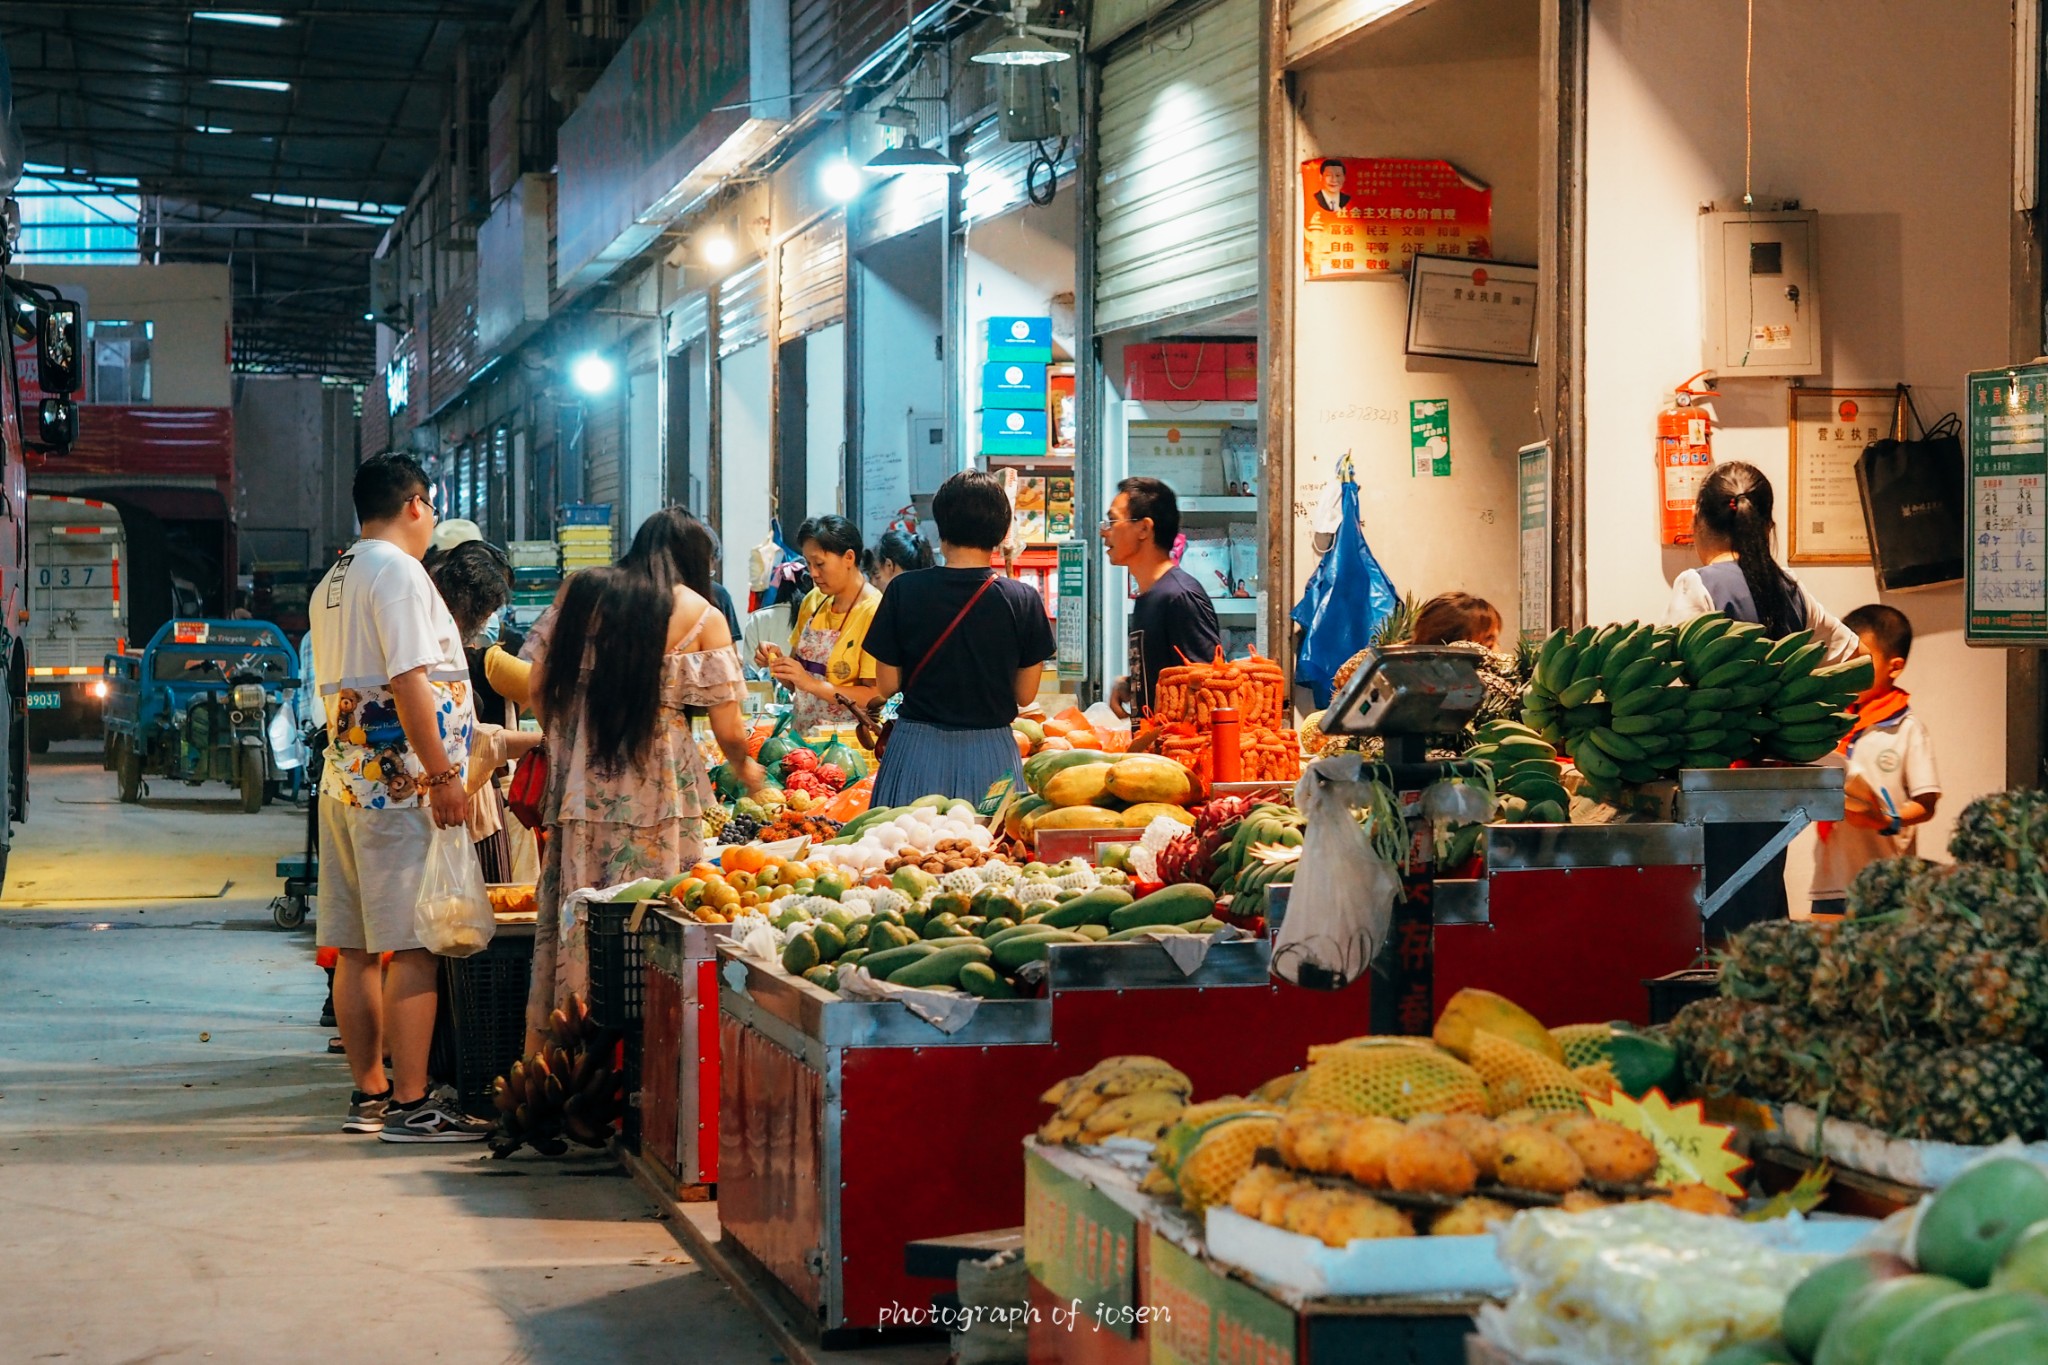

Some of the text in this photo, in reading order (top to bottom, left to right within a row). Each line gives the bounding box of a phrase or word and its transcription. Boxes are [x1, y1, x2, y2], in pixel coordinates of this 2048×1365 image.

[1336, 207, 1456, 220] 社会主义核心价值观
[1331, 225, 1354, 236] 富强
[1366, 225, 1390, 236] 民主
[1401, 226, 1425, 237] 文明
[1331, 242, 1460, 254] 自由 平等 公正 法治
[1331, 259, 1354, 270] 爱国
[1366, 259, 1390, 270] 敬业
[1818, 428, 1878, 441] 营业执照
